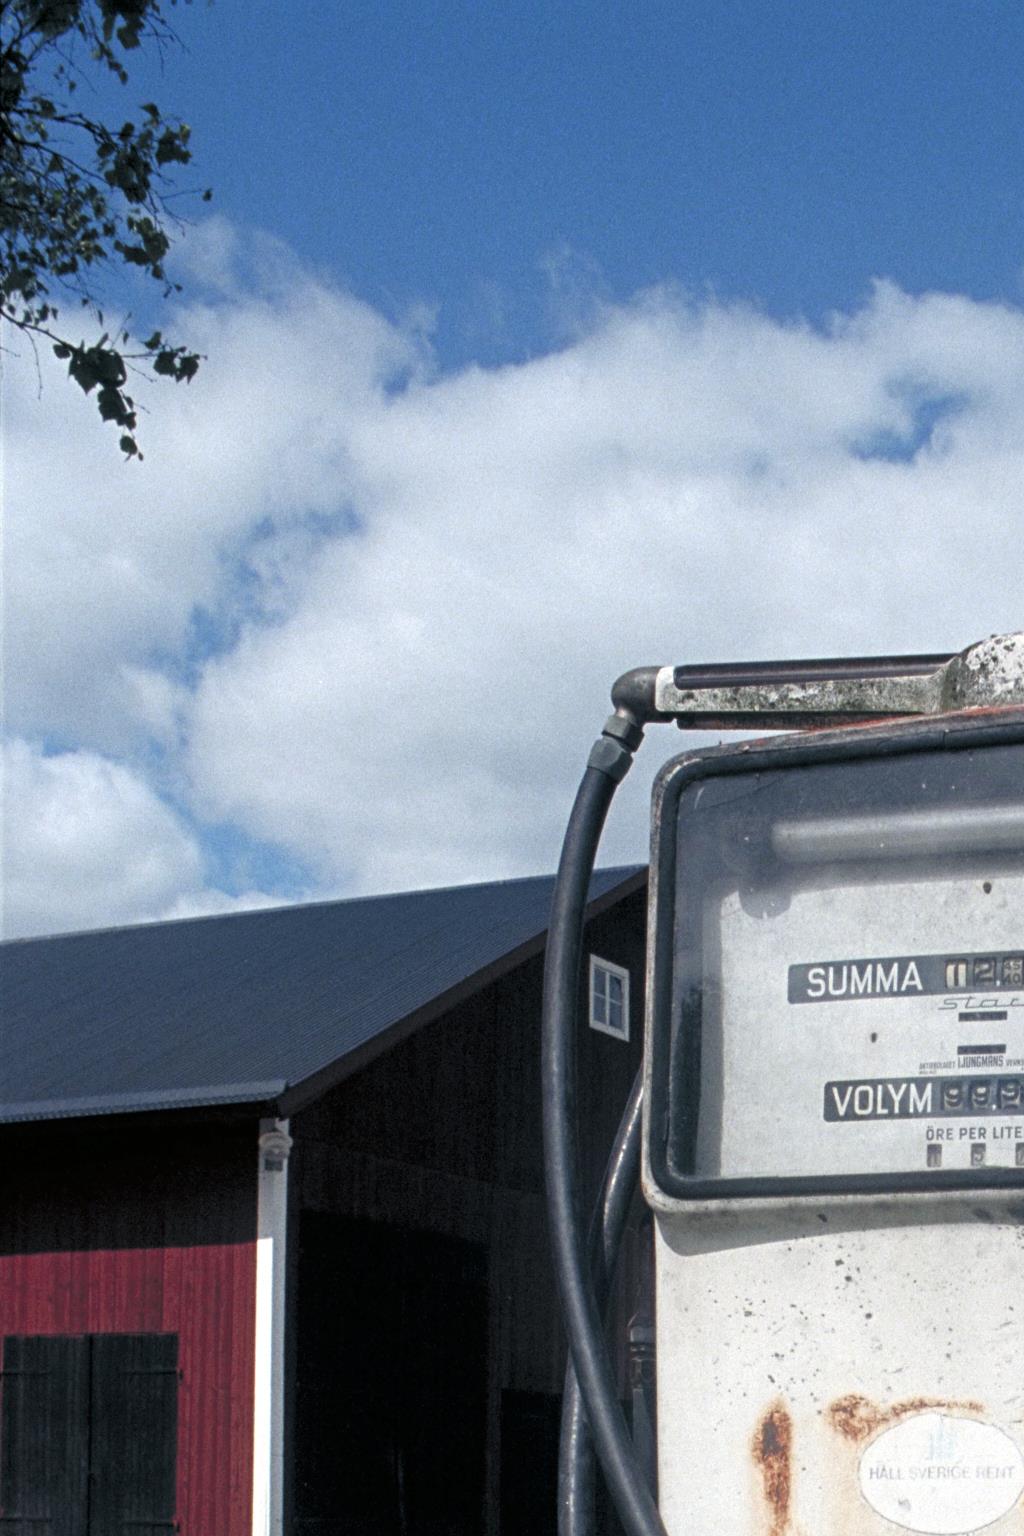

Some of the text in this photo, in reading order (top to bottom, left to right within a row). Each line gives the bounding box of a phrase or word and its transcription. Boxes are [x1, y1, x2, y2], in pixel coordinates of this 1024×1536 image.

[807, 961, 924, 998] SUMMA
[957, 1055, 1004, 1069] LJUNGMANS
[832, 1082, 932, 1117] VOLYM
[926, 1125, 954, 1141] ÖRE
[959, 1127, 987, 1140] PER
[909, 1465, 971, 1481] SVERIGE
[975, 1465, 1016, 1480] RENT
